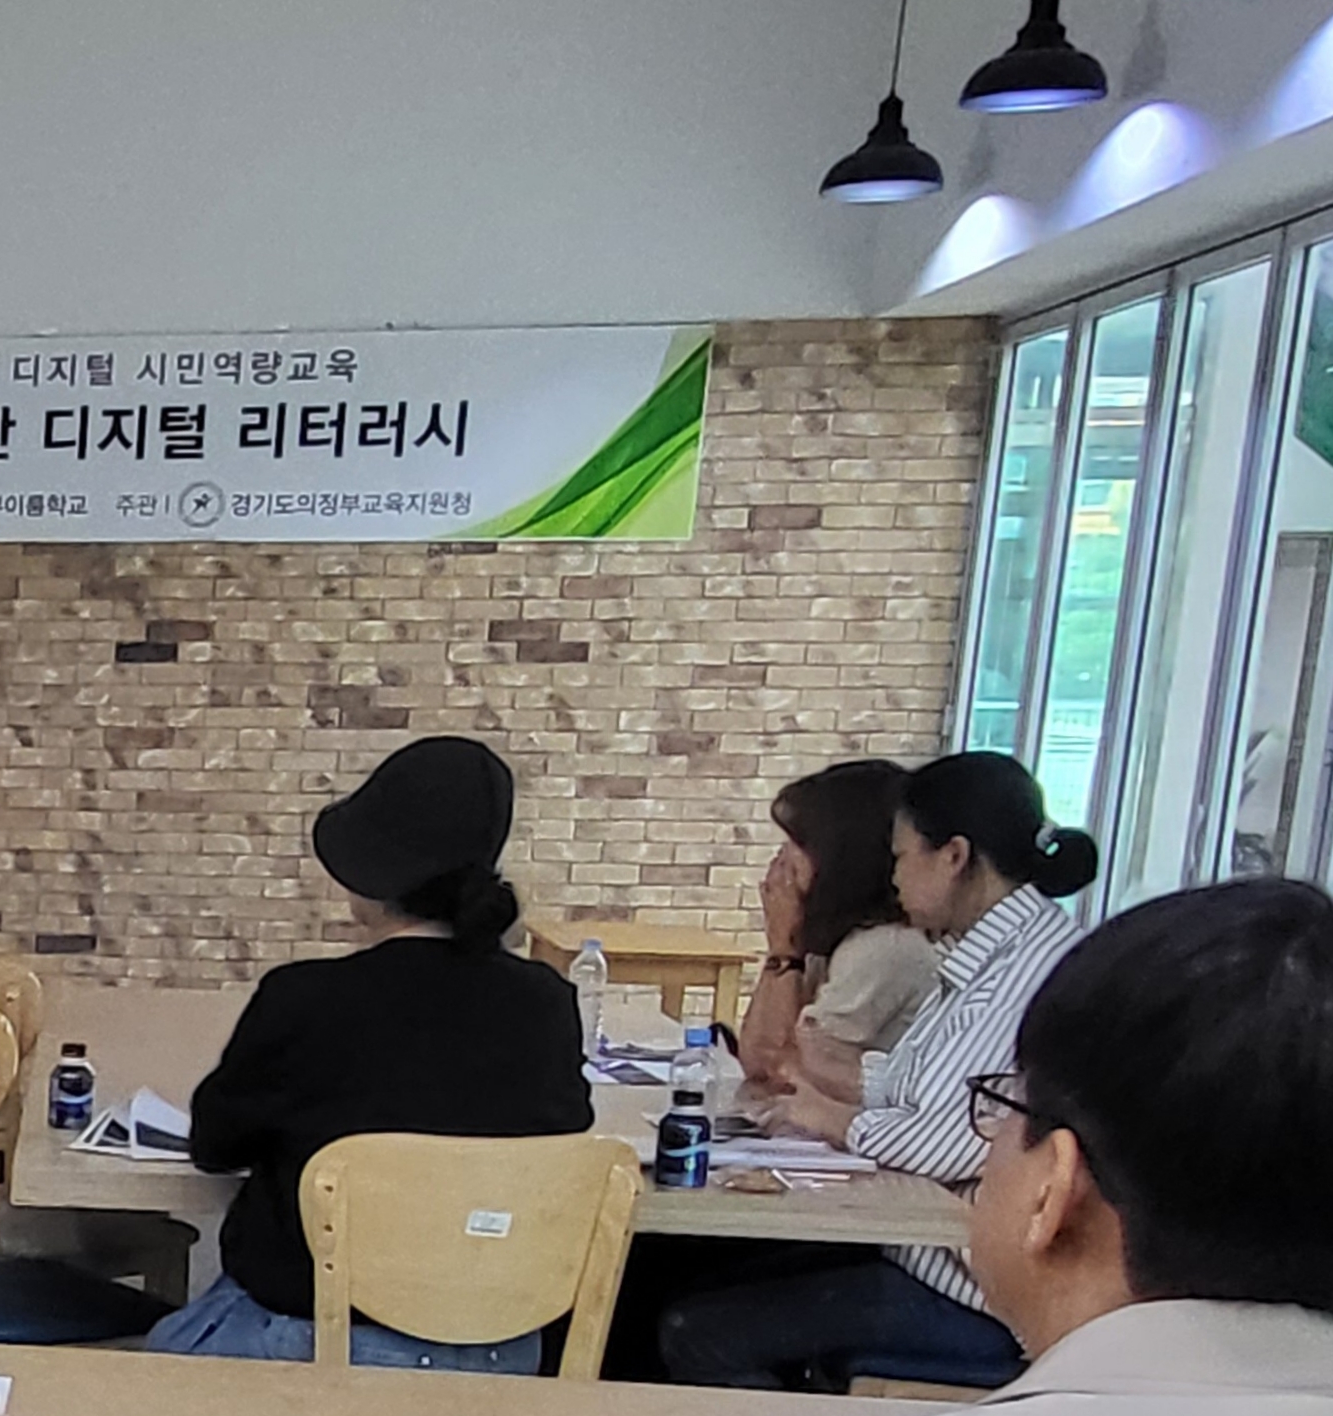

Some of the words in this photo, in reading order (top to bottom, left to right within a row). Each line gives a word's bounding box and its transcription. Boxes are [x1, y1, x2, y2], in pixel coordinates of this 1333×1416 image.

[13, 352, 115, 388] 디지털
[136, 348, 359, 386] 시민역량교육
[42, 403, 208, 460] 디지털
[238, 399, 470, 459] 리터러시
[115, 494, 157, 517] 주관
[231, 491, 472, 518] 경기도의정부교육지원청
